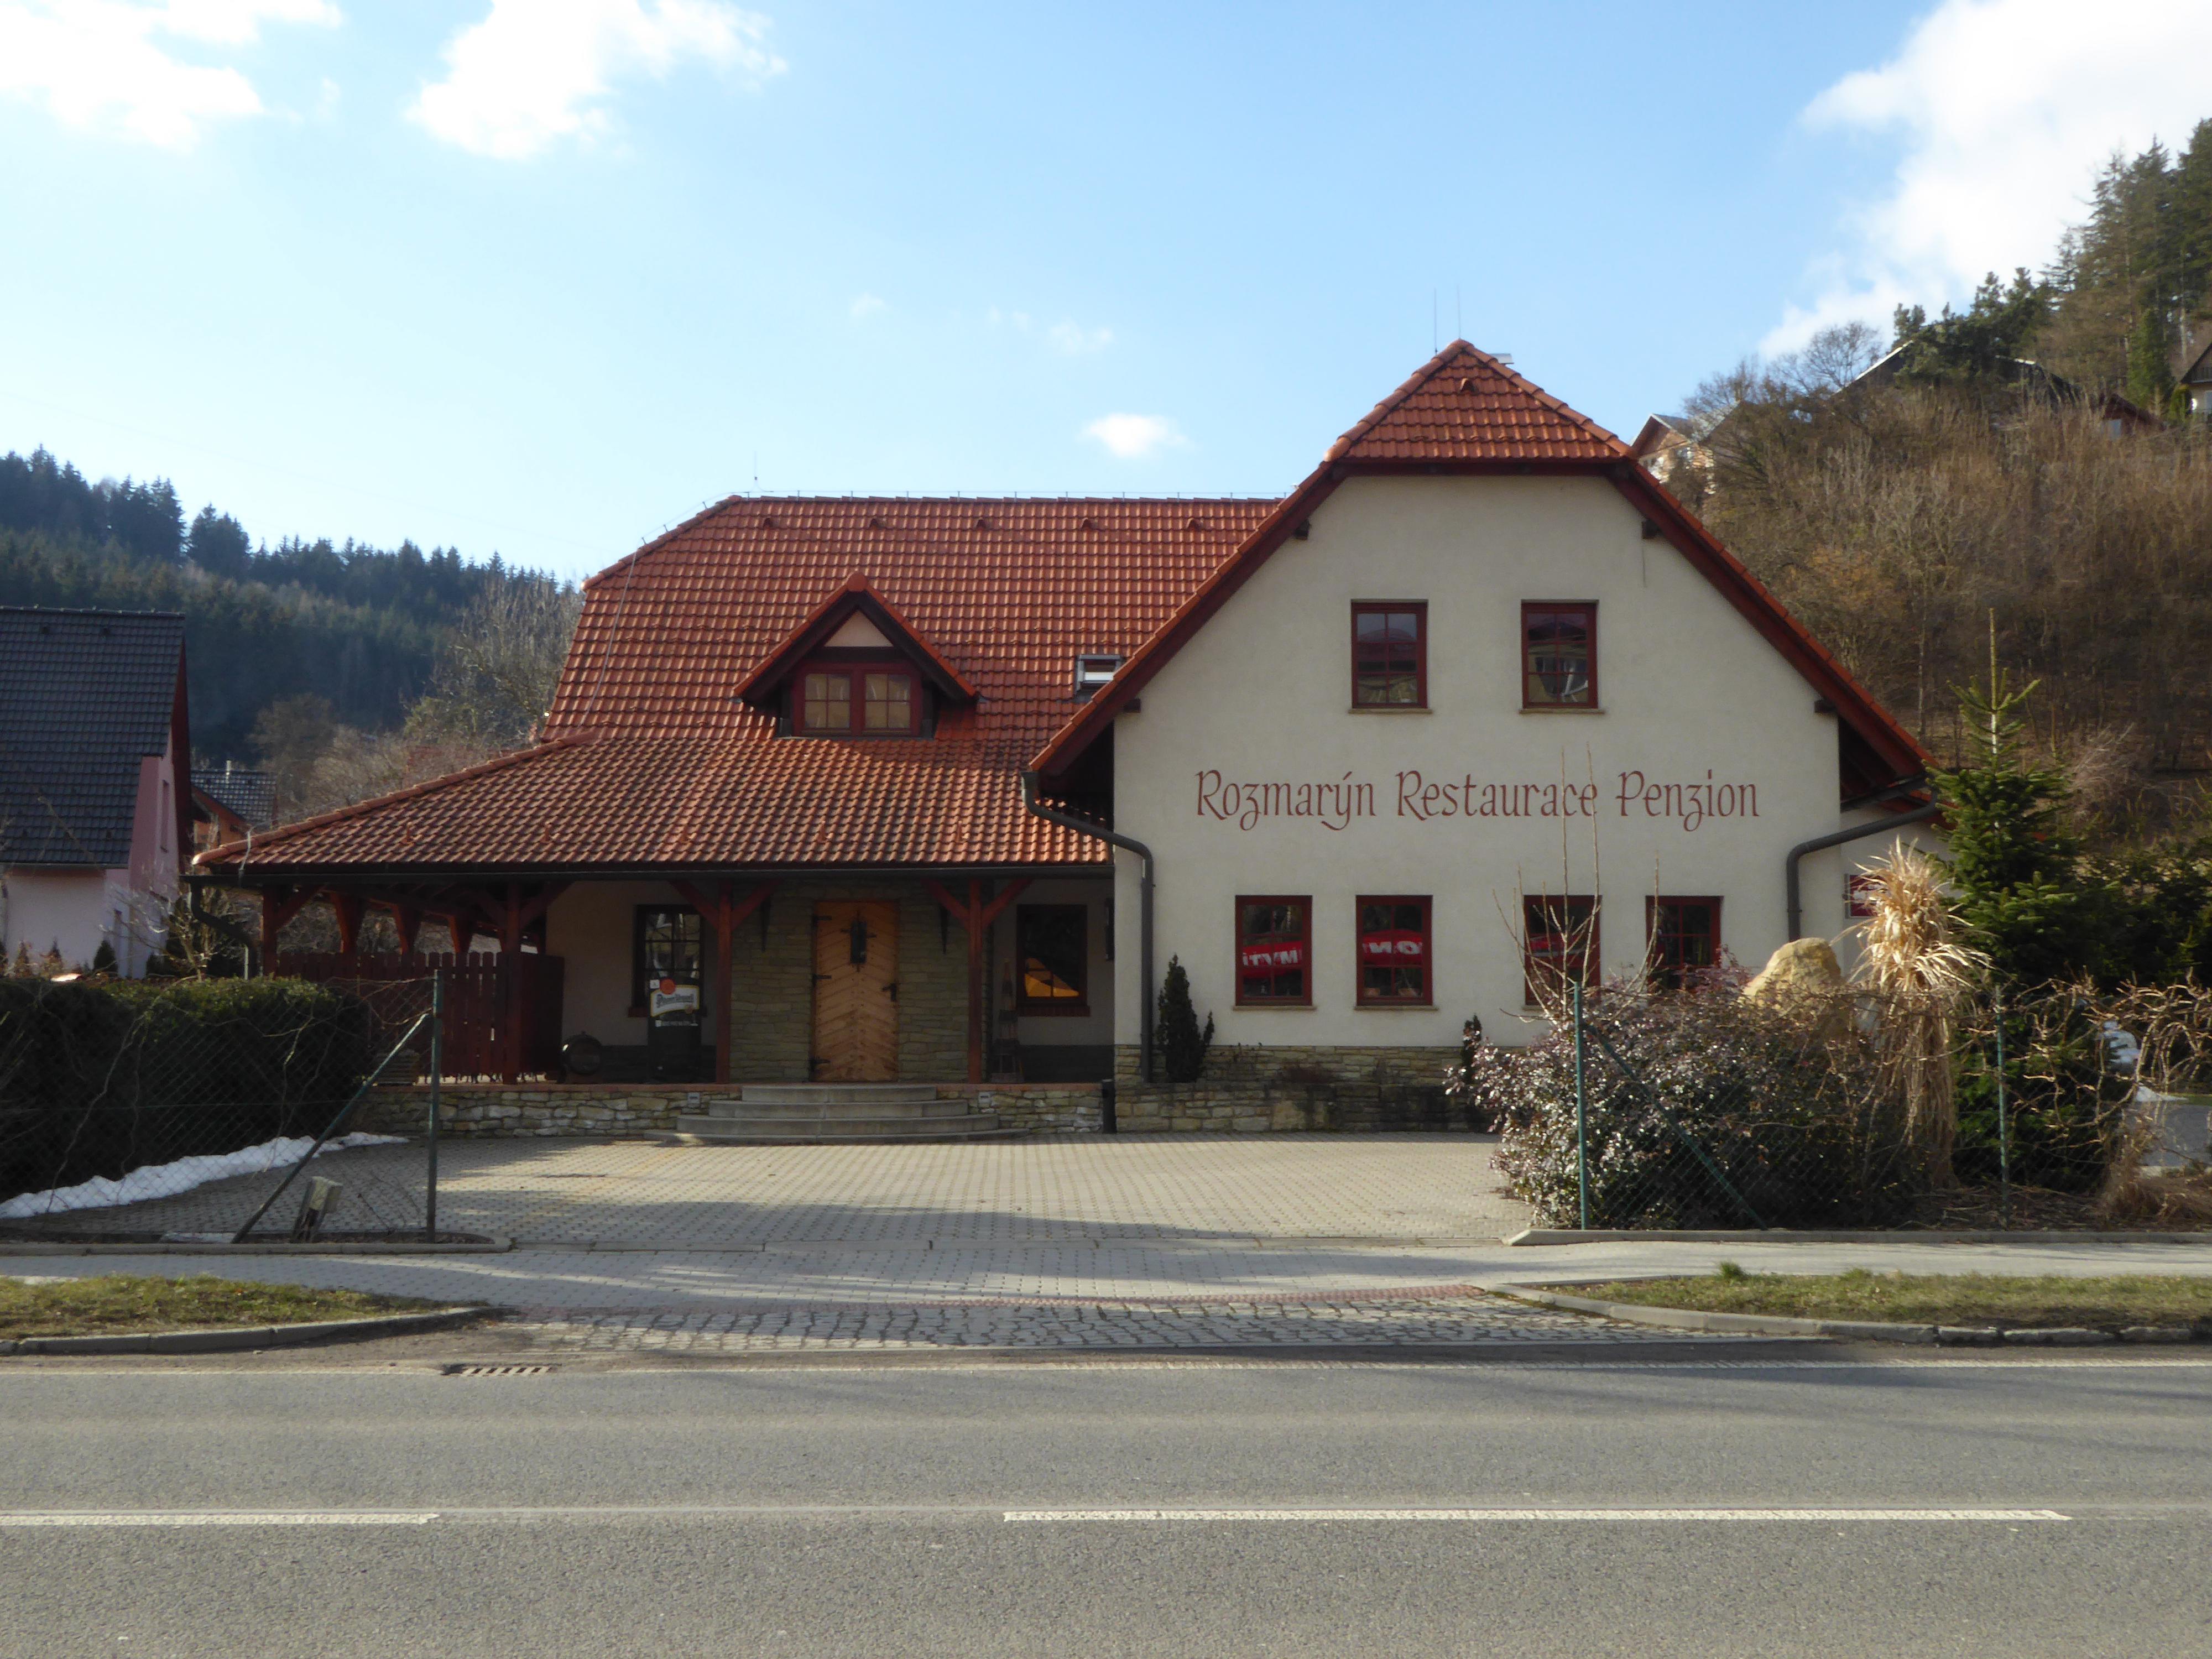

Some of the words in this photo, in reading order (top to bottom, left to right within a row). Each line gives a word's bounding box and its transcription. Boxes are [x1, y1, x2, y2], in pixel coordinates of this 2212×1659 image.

[1196, 769, 1376, 831] Rozmarýn
[1395, 770, 1599, 821] Restaurace
[1615, 769, 1760, 832] Penzion
